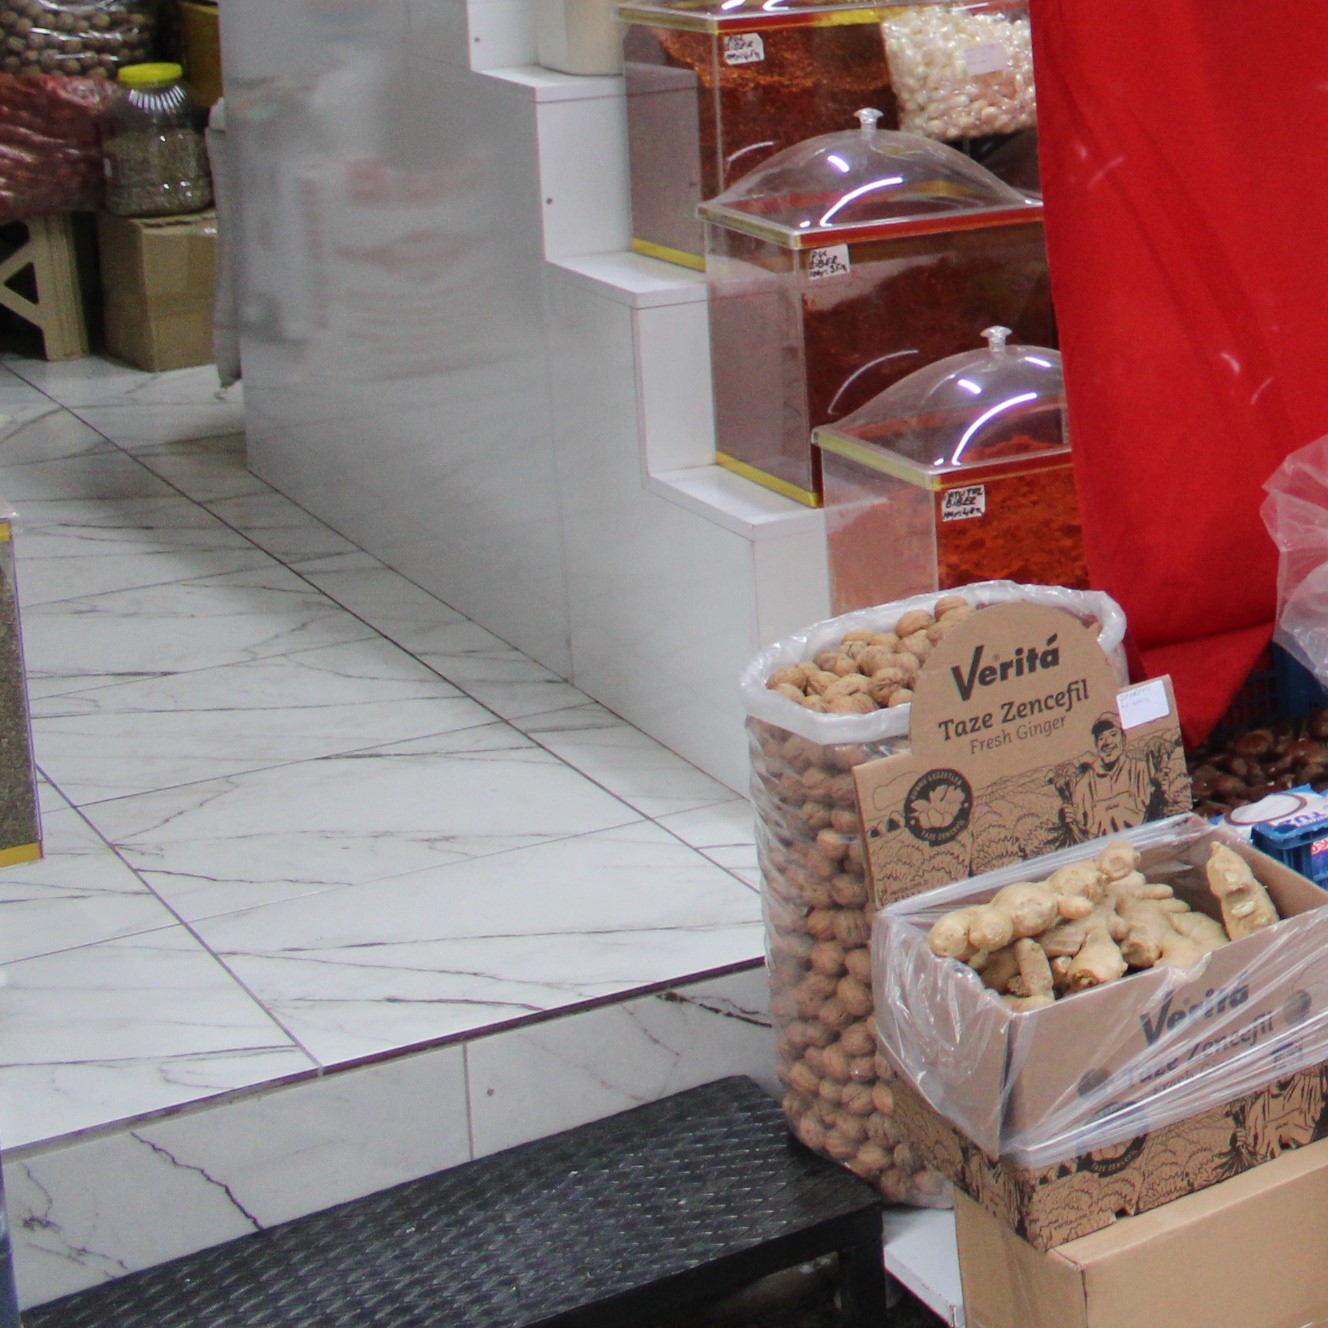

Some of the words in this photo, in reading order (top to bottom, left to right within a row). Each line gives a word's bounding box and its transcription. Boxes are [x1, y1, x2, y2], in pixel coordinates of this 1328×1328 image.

[950, 632, 1061, 702] Veritá
[938, 709, 994, 742] Taze
[1001, 677, 1090, 725] Zencefil
[969, 731, 1013, 755] Fresh
[1020, 715, 1067, 745] Ginger
